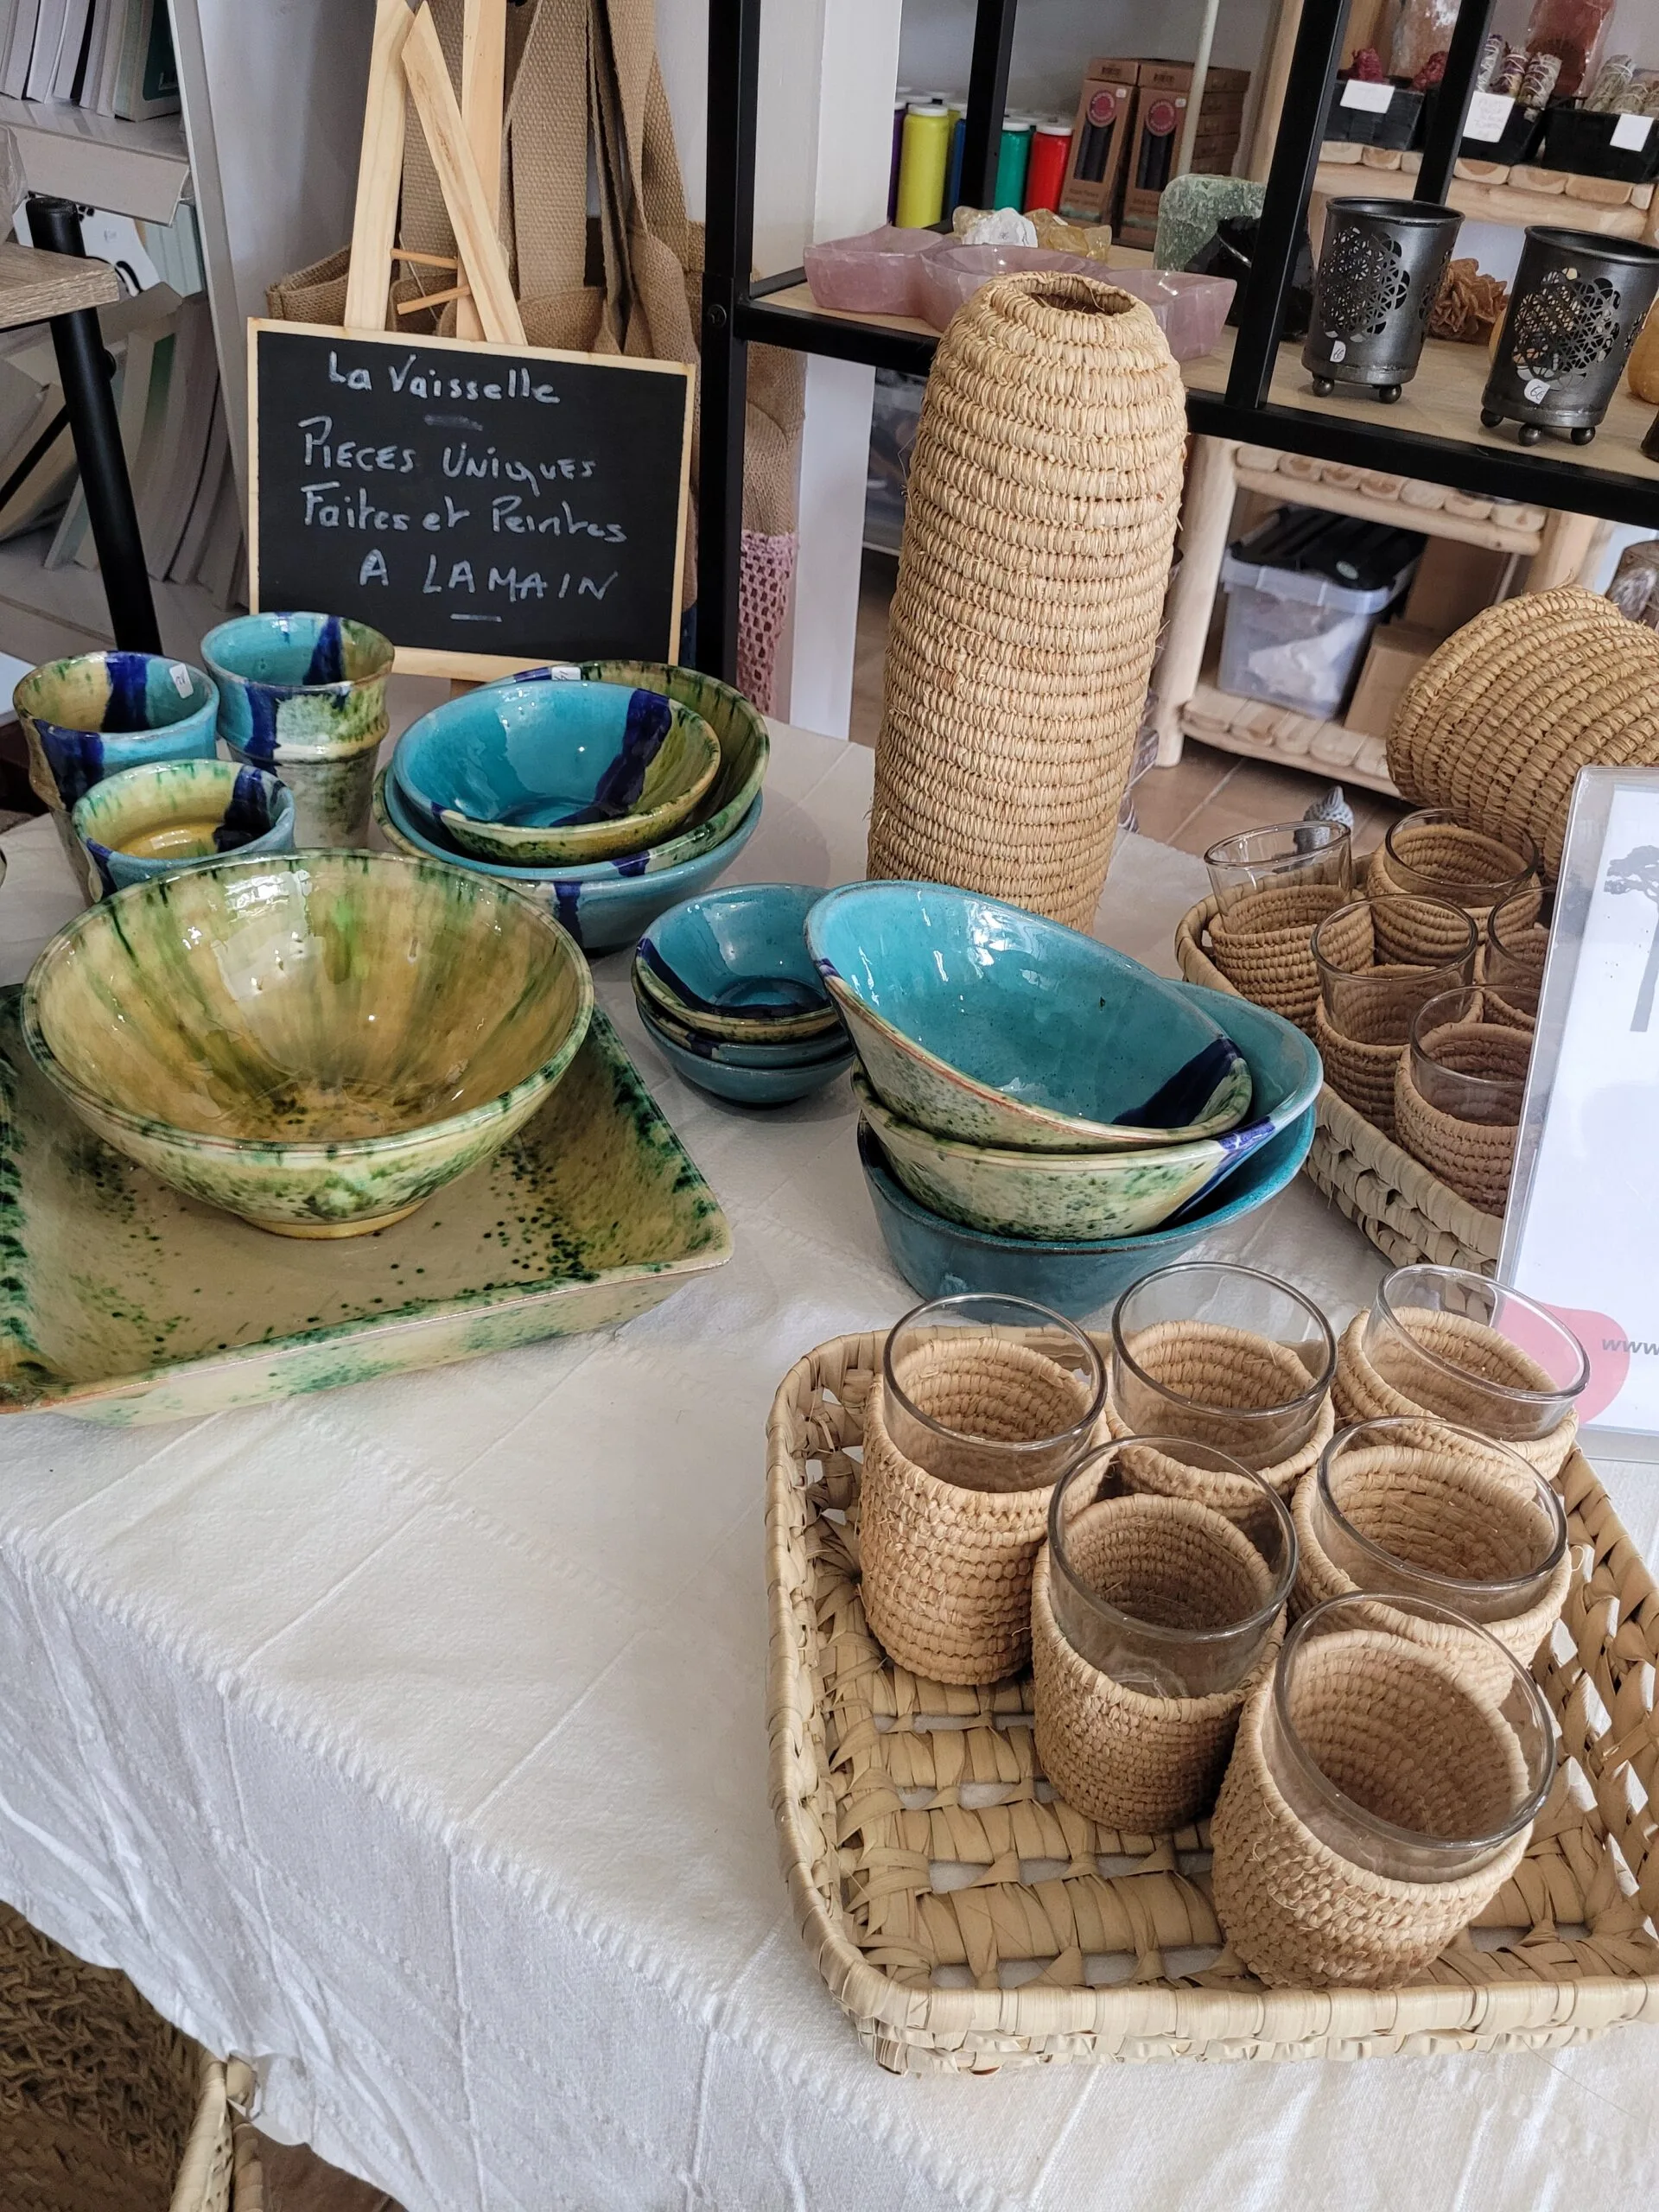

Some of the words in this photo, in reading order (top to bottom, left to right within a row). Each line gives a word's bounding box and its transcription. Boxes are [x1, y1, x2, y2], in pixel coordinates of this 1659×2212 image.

[328, 350, 373, 391] La
[388, 353, 562, 405] Vaisselle
[297, 415, 416, 475] PIECES
[300, 480, 411, 531] Faites
[422, 495, 472, 533] et
[492, 495, 629, 544] Peintes
[359, 549, 390, 588] A
[423, 554, 476, 595] LA
[488, 567, 619, 604] MAIN
